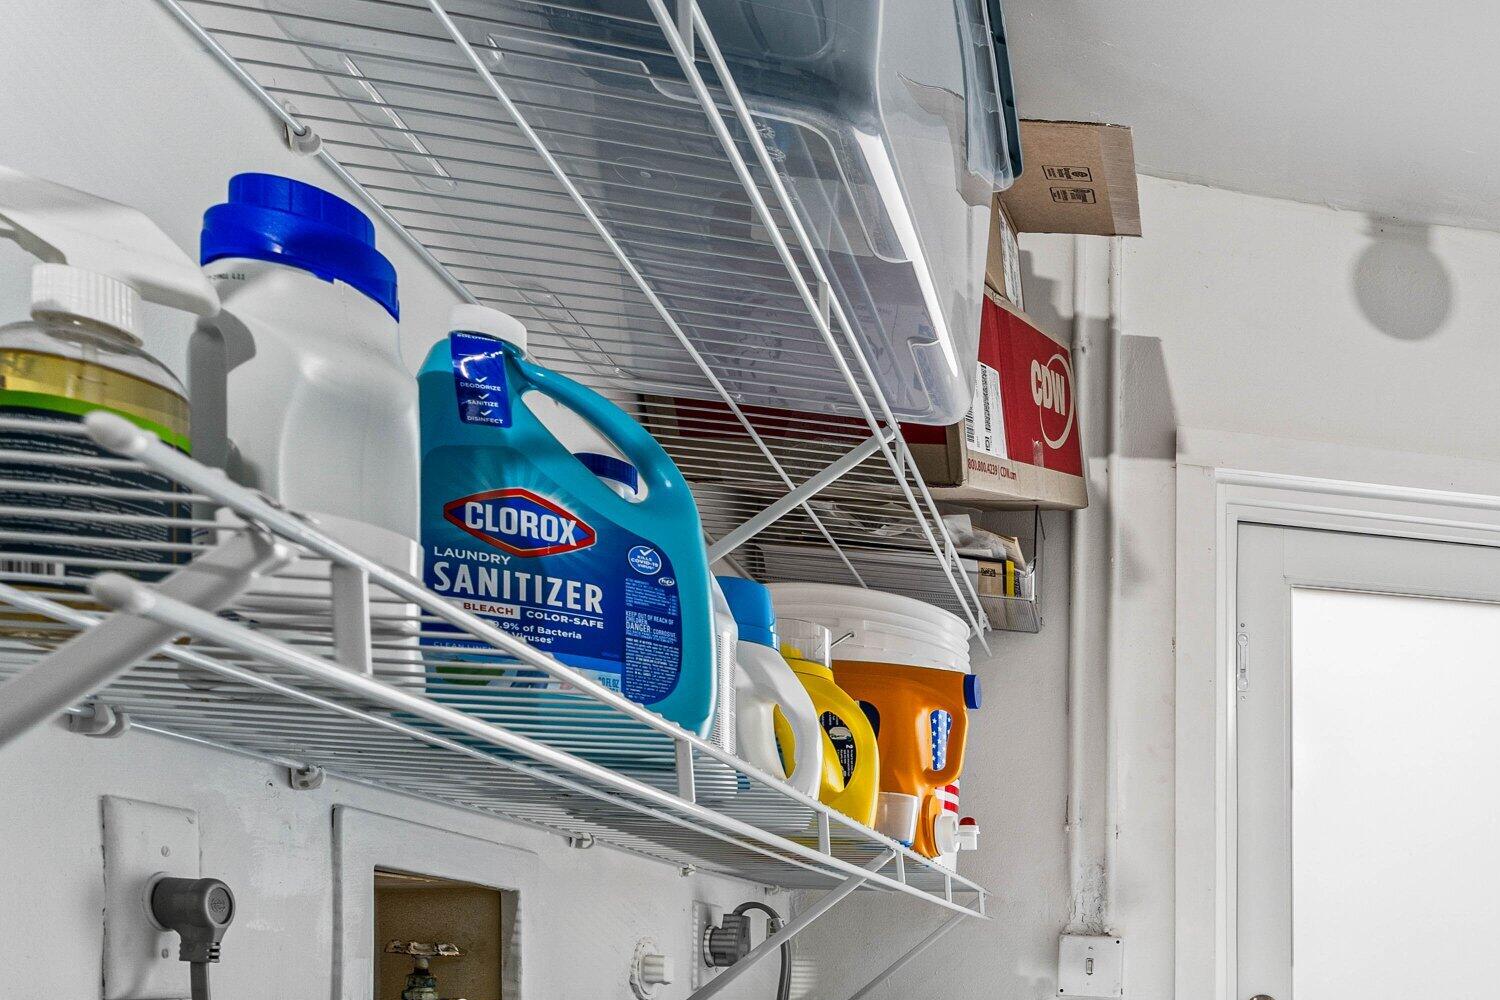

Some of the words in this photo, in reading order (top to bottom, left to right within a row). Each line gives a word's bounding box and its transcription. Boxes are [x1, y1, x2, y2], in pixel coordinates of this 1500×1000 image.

[460, 381, 502, 392] DEODORIZE
[1031, 360, 1065, 416] CDW
[467, 400, 499, 408] SANITIZE
[467, 416, 504, 424] DISINFECT
[465, 501, 577, 546] CLOROX
[434, 546, 511, 565] LAUNDRY
[433, 561, 603, 614] SANITIZER
[463, 602, 514, 616] BLEACH
[526, 610, 604, 629] COLOR-SAFE
[537, 626, 582, 639] Bacteria
